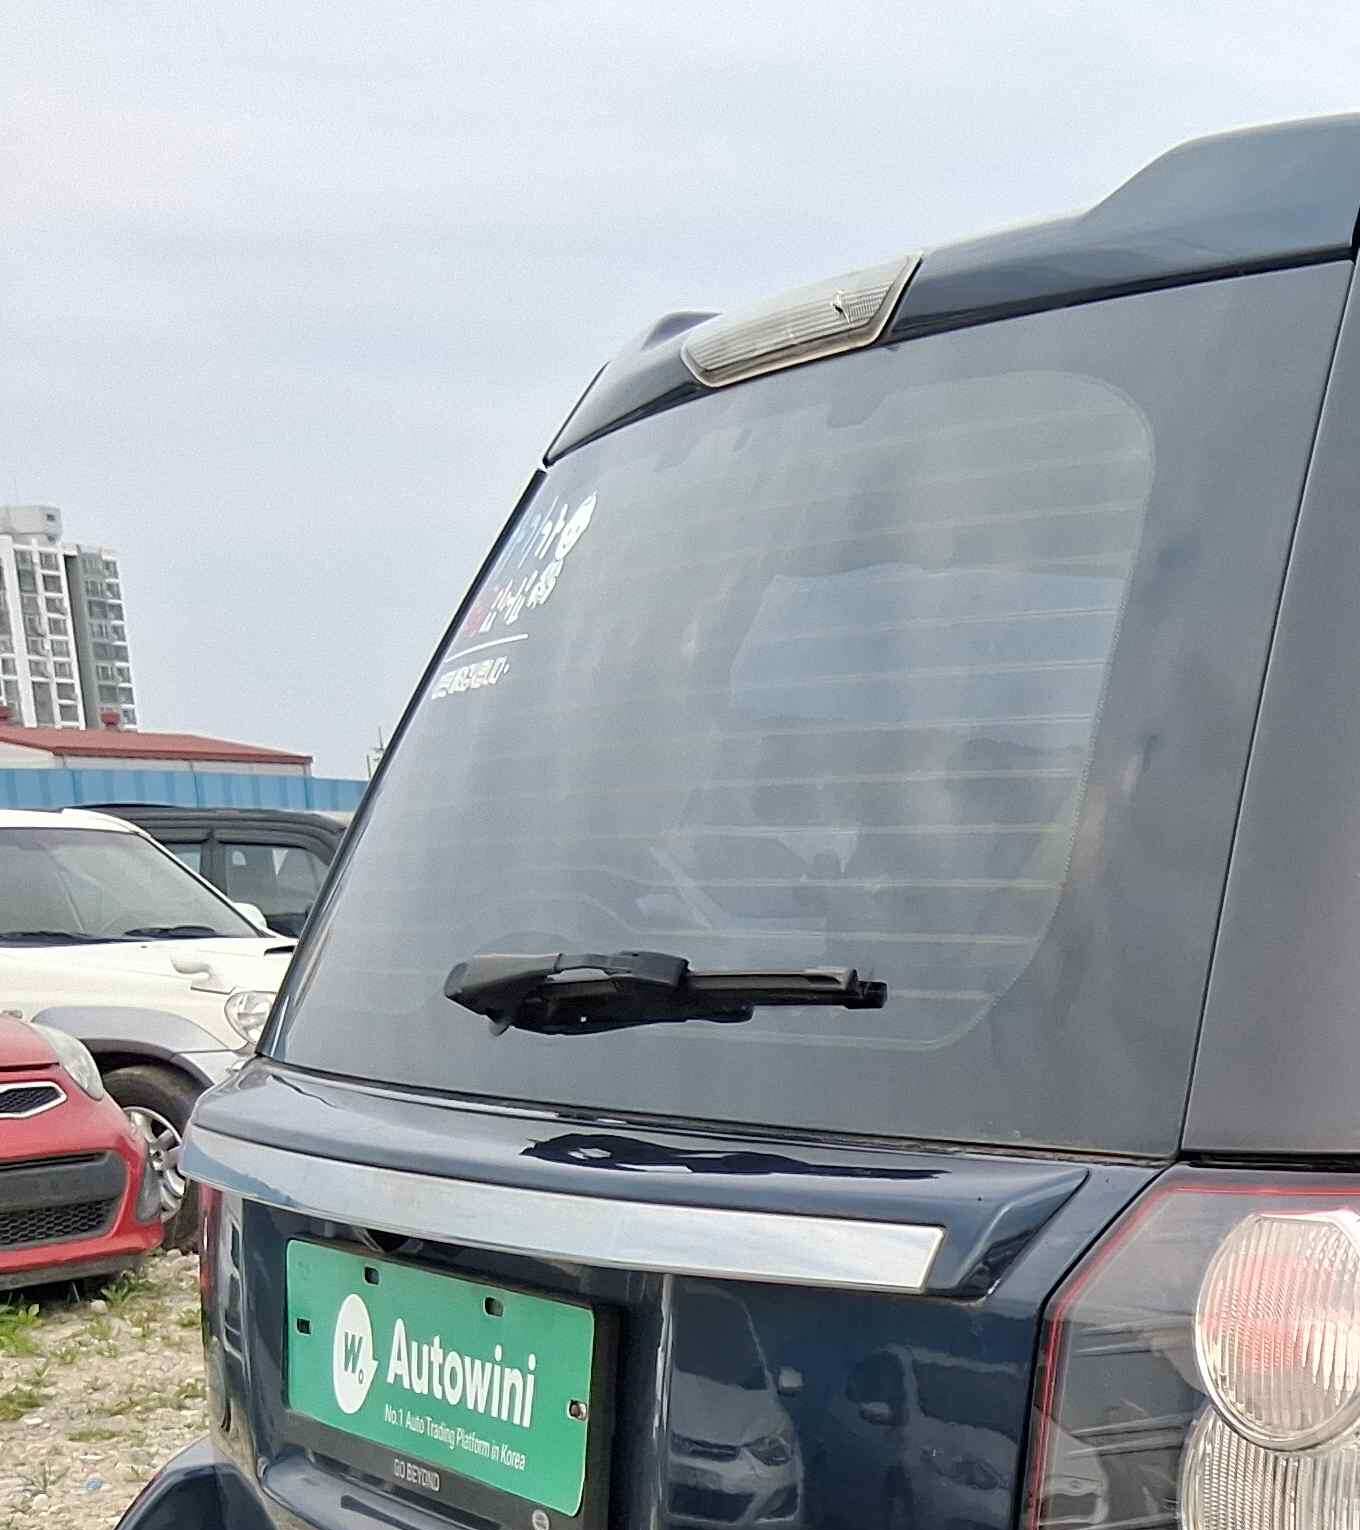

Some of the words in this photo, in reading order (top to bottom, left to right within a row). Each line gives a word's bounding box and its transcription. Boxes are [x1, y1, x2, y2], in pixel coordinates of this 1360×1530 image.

[386, 1318, 537, 1429] Autowini
[404, 1410, 425, 1434] Auto
[426, 1418, 455, 1449] Trading
[456, 1428, 490, 1457] Platform
[490, 1441, 500, 1461] in
[500, 1444, 526, 1471] Korea
[393, 1459, 406, 1478] GO
[406, 1463, 441, 1492] BEYOND
